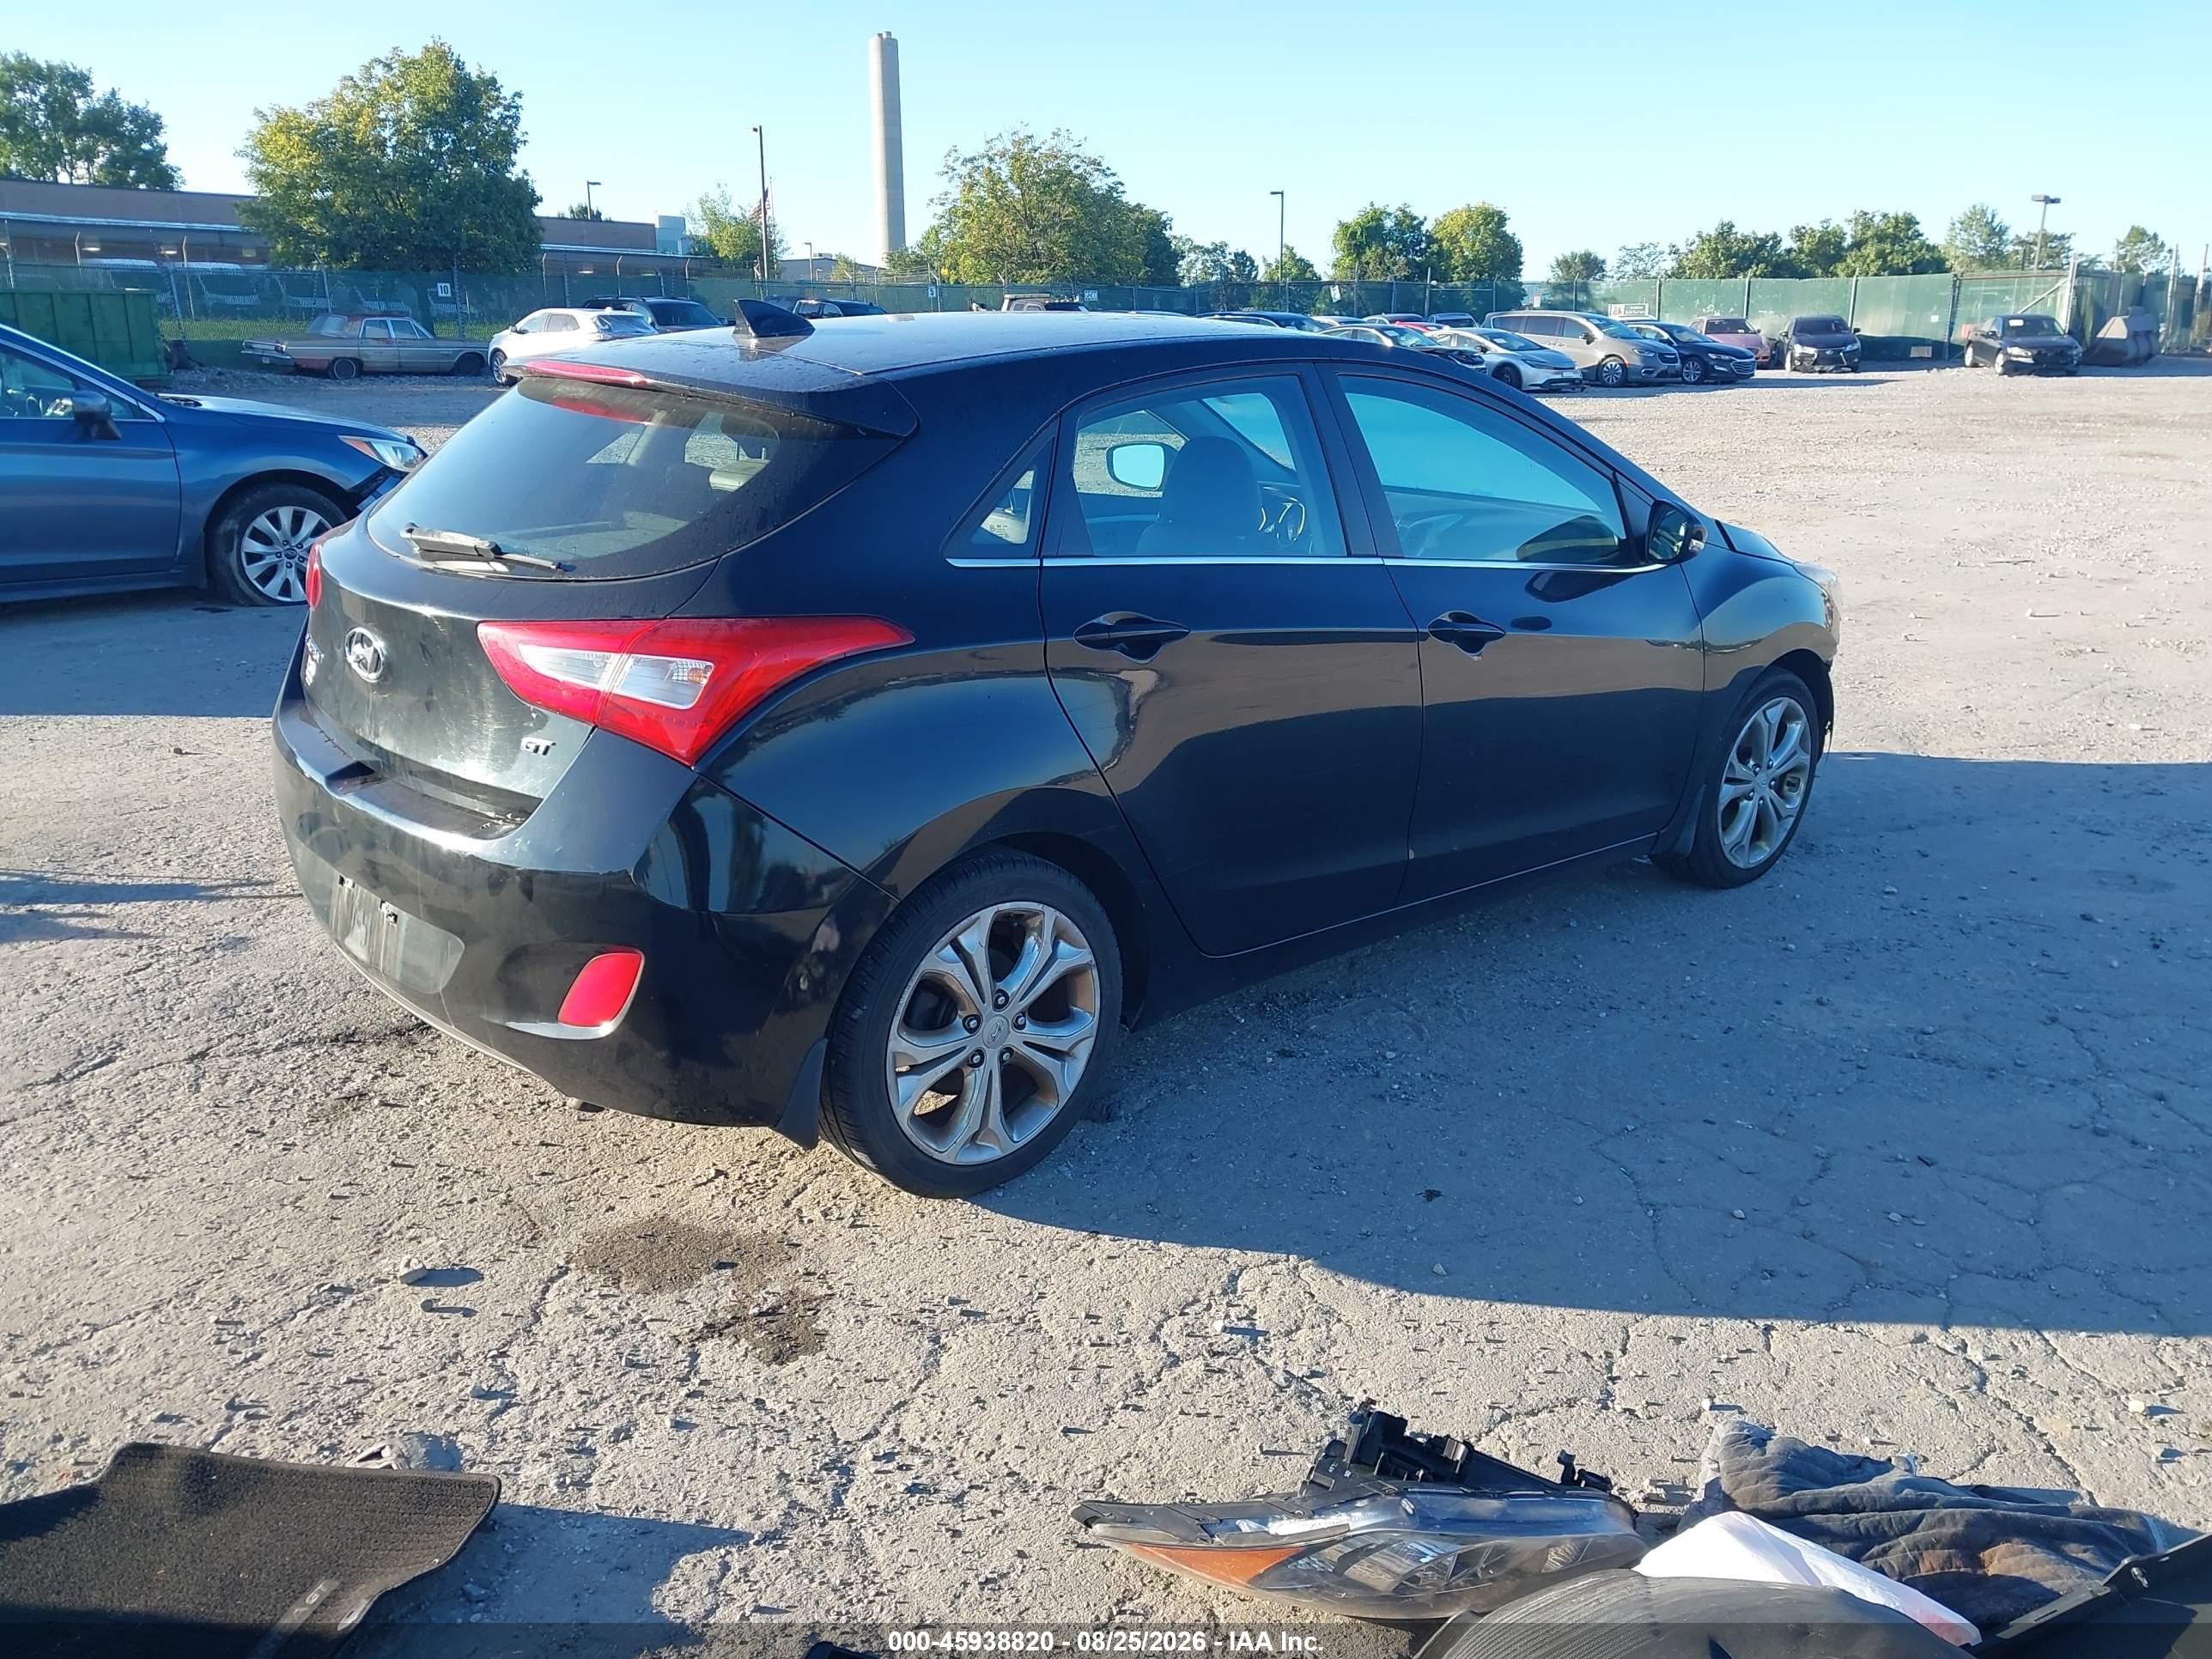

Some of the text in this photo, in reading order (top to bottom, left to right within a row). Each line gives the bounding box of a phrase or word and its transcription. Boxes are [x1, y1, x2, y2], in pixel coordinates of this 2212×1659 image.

[440, 284, 449, 295] 10
[520, 738, 557, 757] GT
[305, 1582, 328, 1604] GT
